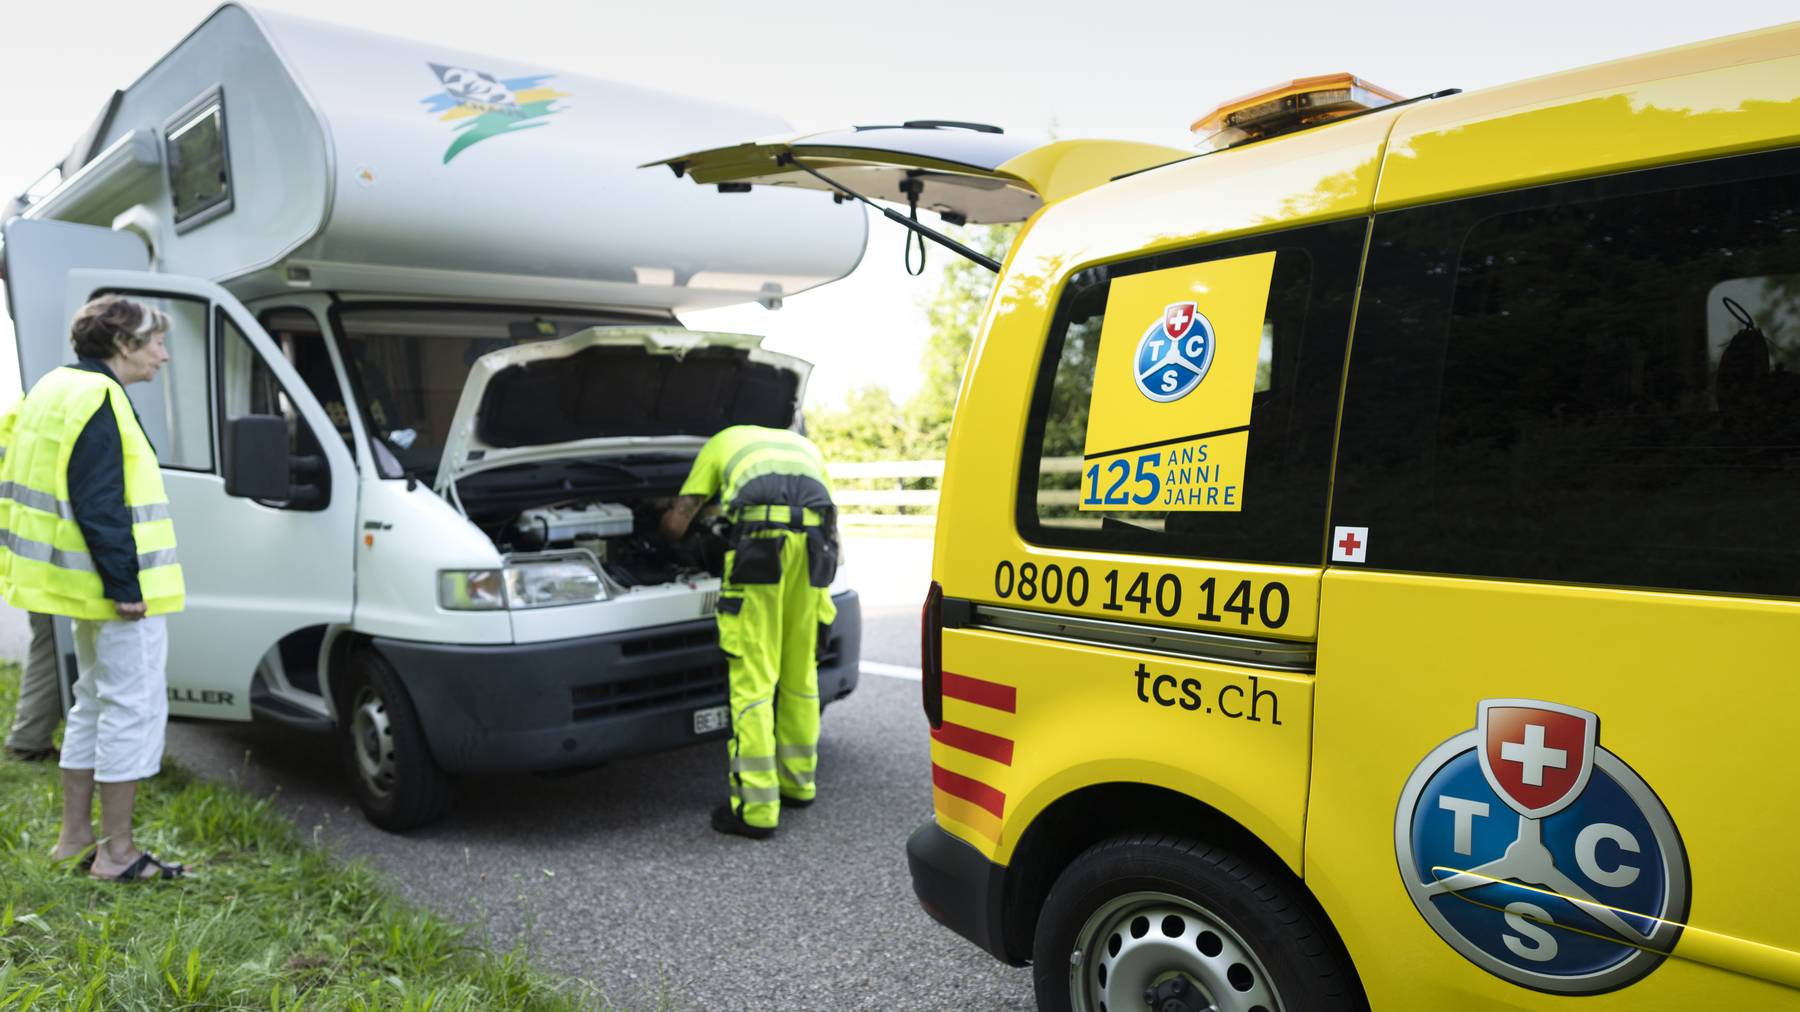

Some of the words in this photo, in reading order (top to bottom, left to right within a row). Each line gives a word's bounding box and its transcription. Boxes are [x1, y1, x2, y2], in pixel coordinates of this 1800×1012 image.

[1168, 444, 1208, 466] ANS
[1084, 453, 1161, 505] 125
[1165, 464, 1220, 486] ANNI
[1164, 486, 1236, 506] JAHRE
[994, 560, 1090, 607] 0800
[1102, 569, 1183, 617] 140
[1197, 577, 1290, 629] 140
[1134, 663, 1282, 725] tcs.ch
